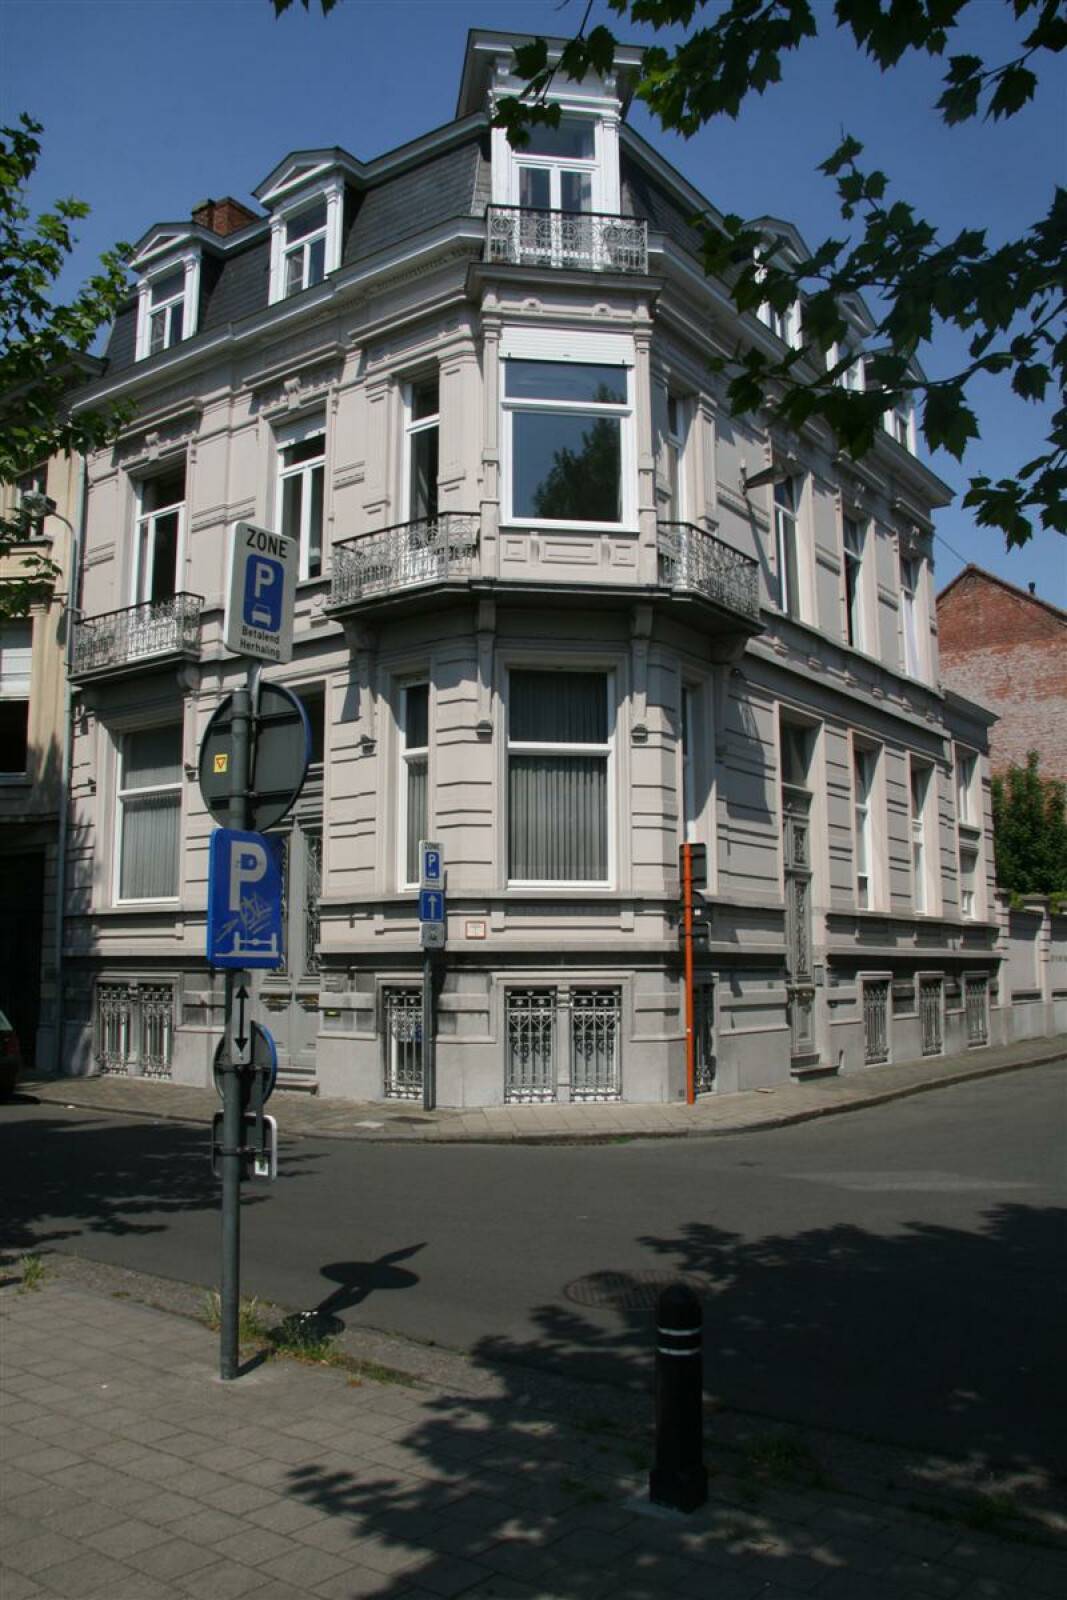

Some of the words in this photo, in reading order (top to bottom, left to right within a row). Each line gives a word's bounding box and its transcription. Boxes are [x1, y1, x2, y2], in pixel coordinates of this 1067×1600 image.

[246, 528, 288, 558] ZONE
[254, 562, 275, 598] P
[240, 638, 280, 659] Herhaling
[242, 625, 280, 645] Betalend
[229, 841, 268, 912] P
